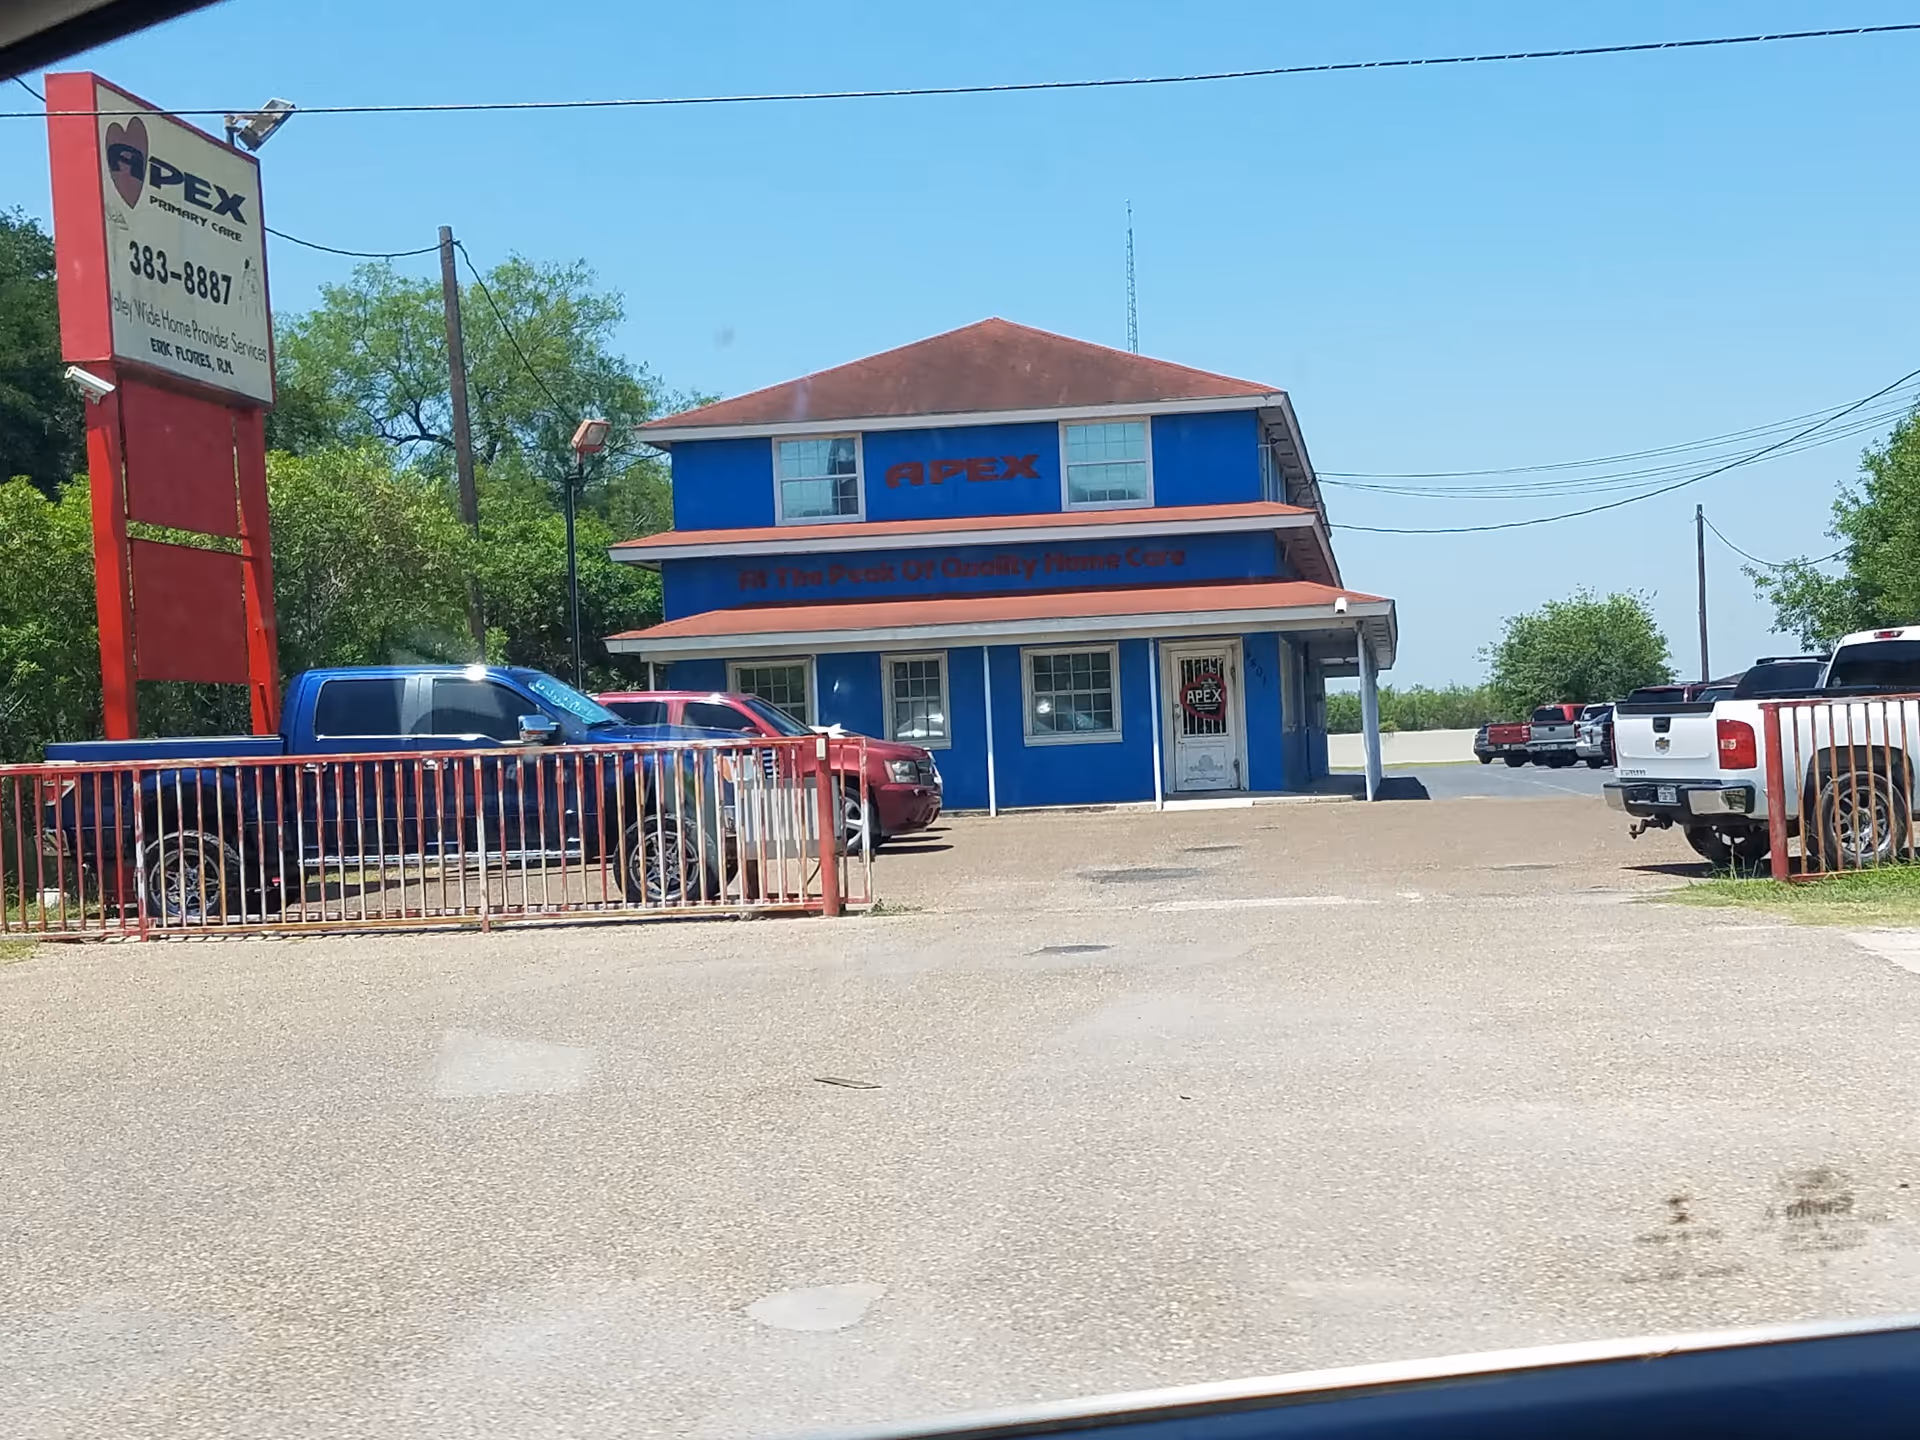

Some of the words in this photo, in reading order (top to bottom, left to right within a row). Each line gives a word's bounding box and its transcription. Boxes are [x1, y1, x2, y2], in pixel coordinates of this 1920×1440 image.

[107, 143, 247, 225] APEX
[150, 195, 208, 227] PRIMARY
[211, 222, 242, 242] CARE
[129, 240, 232, 305] 383-8887
[133, 298, 160, 328] Wide
[162, 310, 192, 338] Home
[192, 319, 229, 351] Provider
[231, 332, 267, 363] Services
[150, 337, 173, 356] ERIC
[885, 454, 1041, 489] APEX
[775, 566, 823, 588] The
[828, 561, 897, 585] Peak
[901, 558, 936, 582] Of
[940, 555, 1038, 581] Quality
[1043, 551, 1122, 574] Home
[1125, 548, 1186, 568] Care
[1186, 688, 1222, 704] APEX
